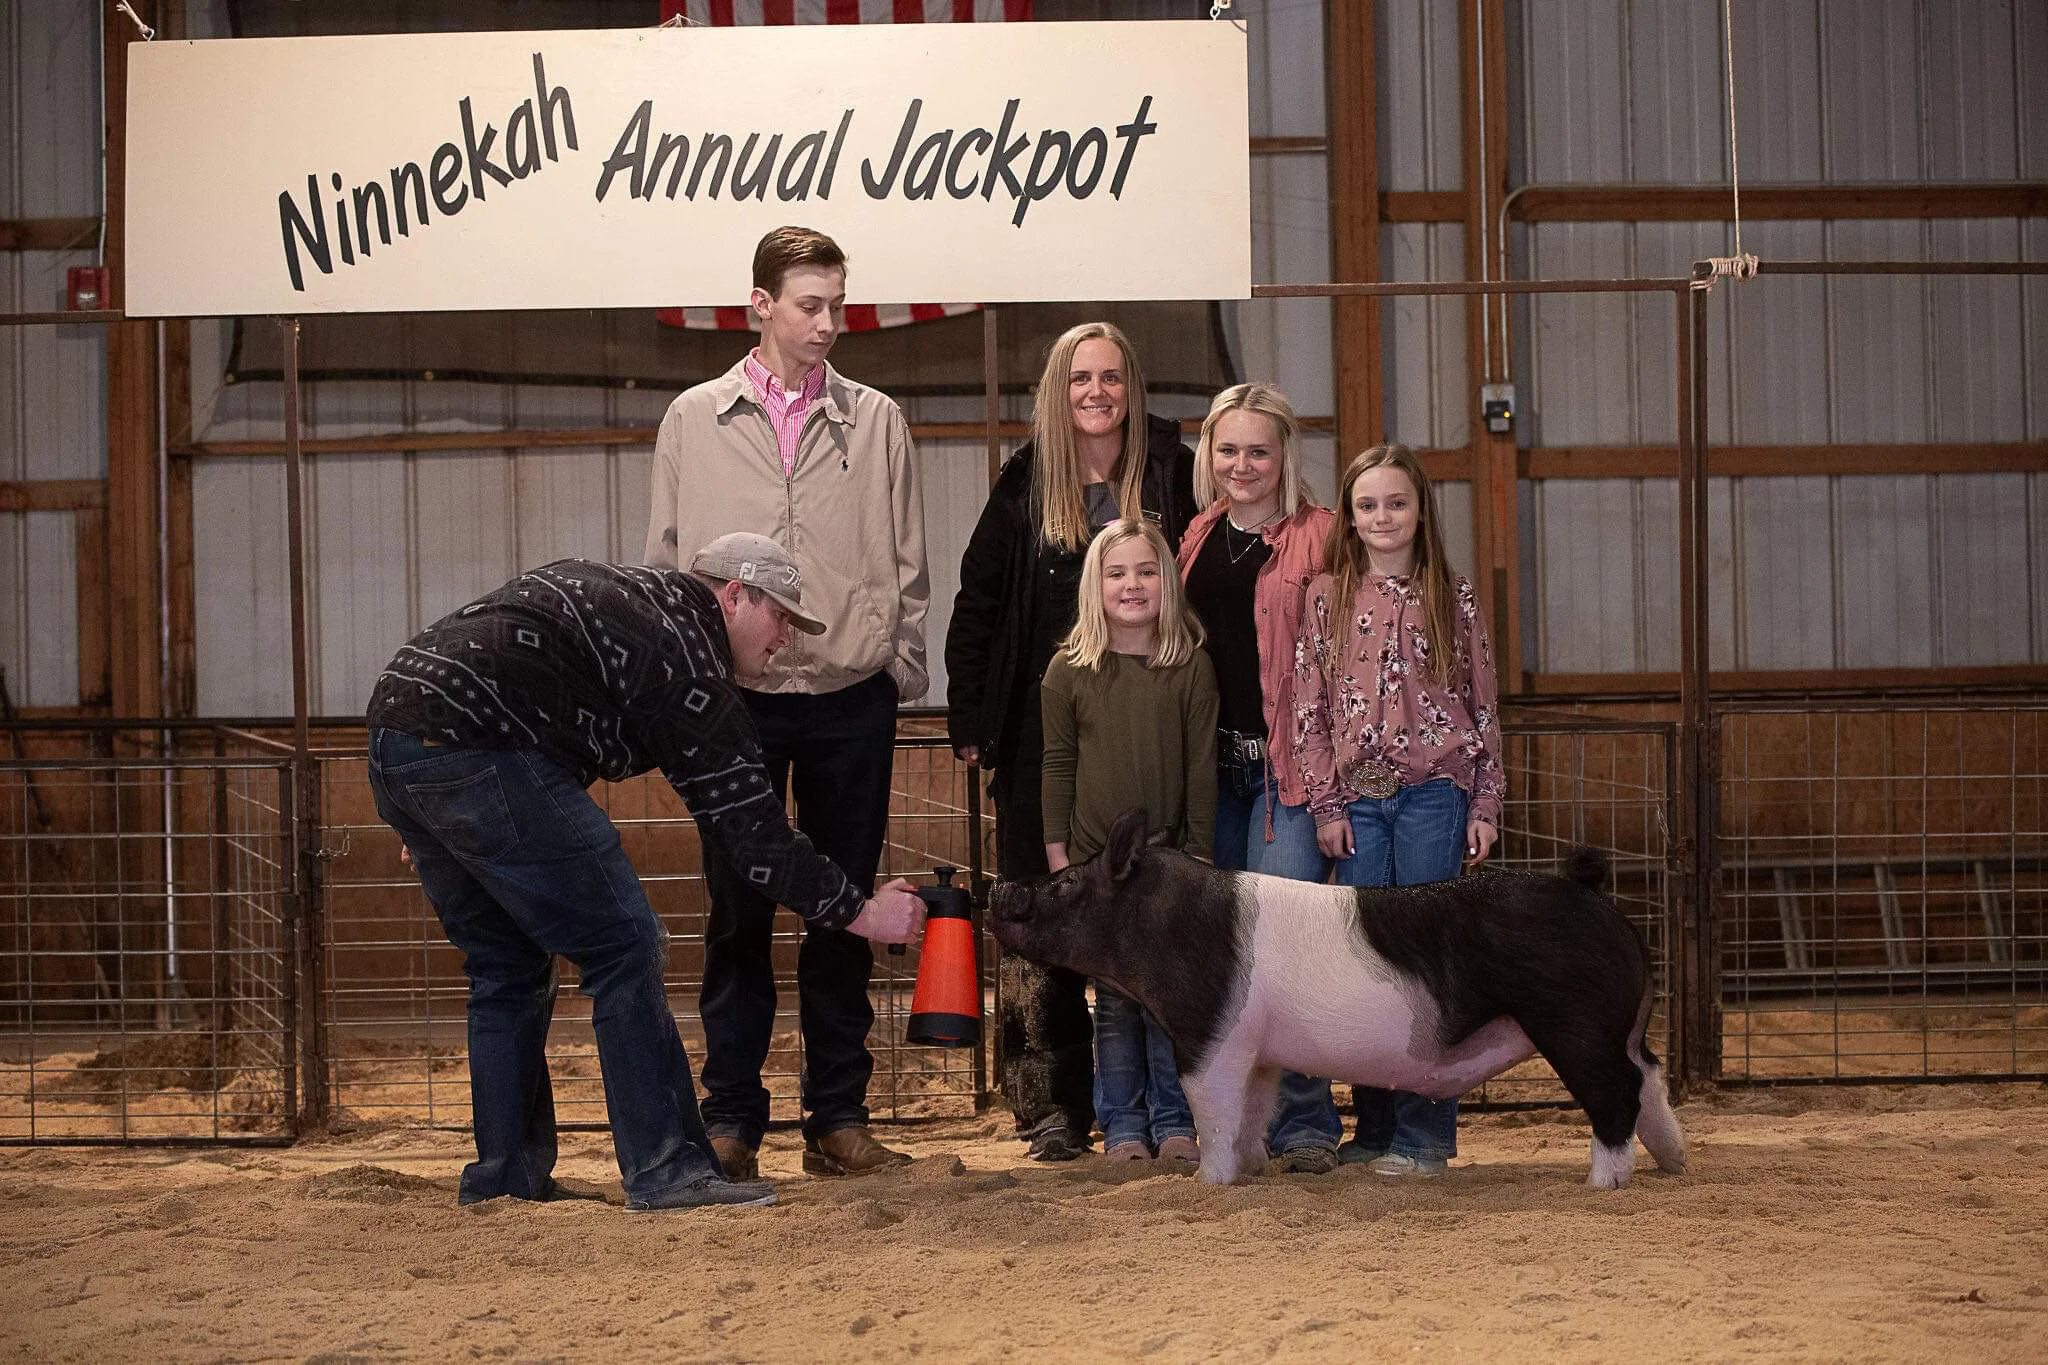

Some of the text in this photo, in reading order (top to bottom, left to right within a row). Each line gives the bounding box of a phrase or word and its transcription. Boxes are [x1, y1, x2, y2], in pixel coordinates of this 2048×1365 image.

[278, 52, 1158, 292] Ninnekah Annual Jackpot
